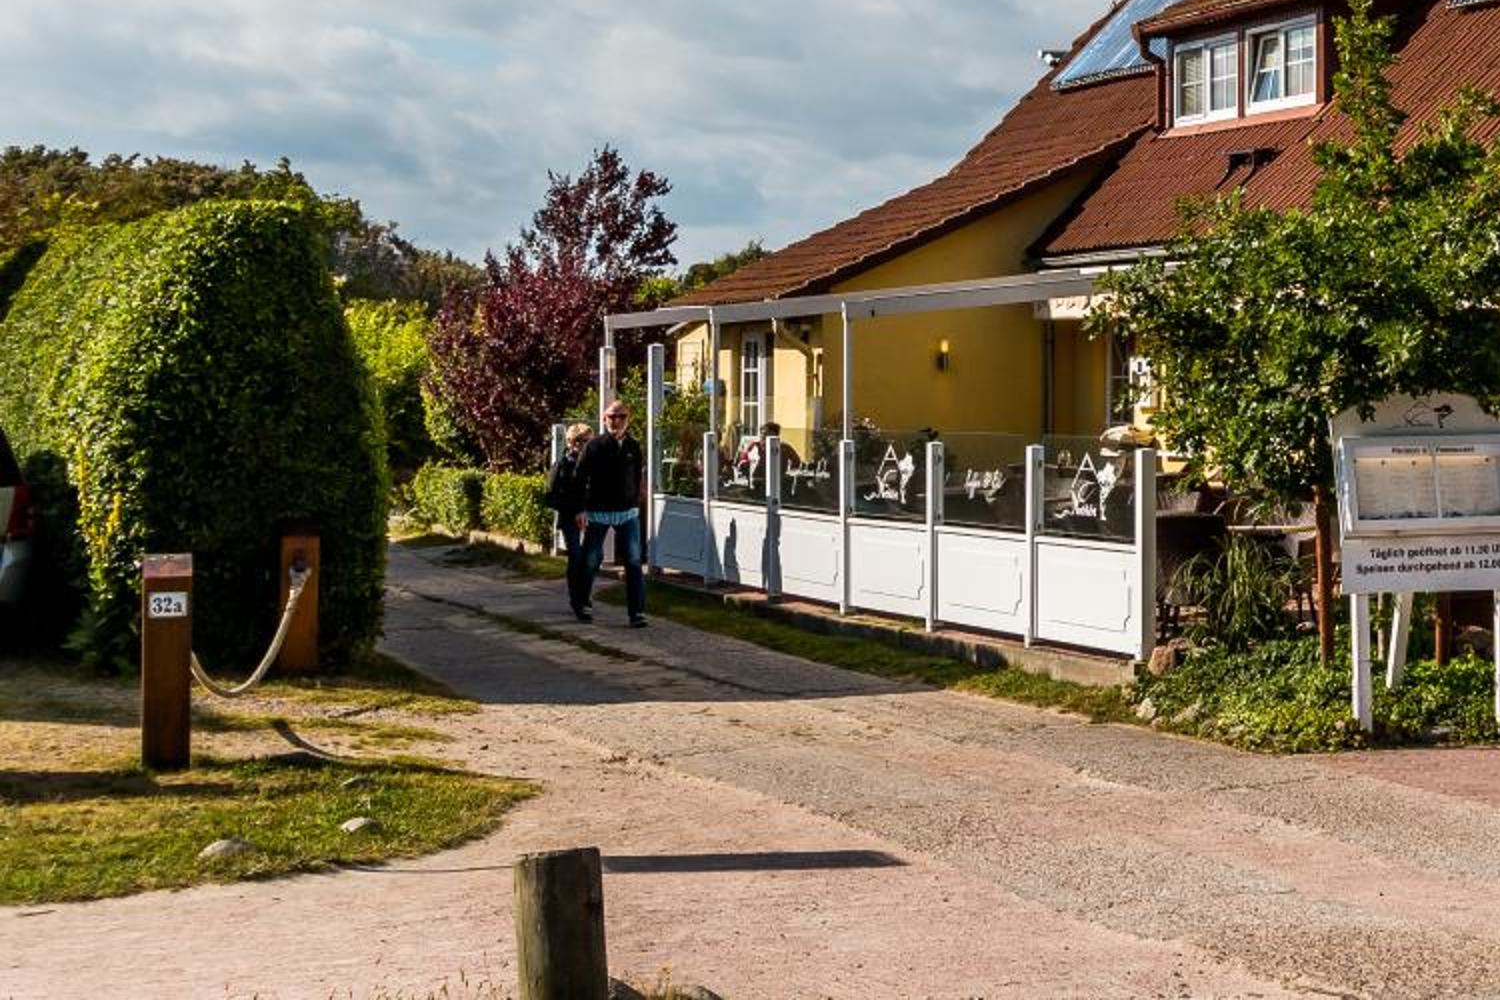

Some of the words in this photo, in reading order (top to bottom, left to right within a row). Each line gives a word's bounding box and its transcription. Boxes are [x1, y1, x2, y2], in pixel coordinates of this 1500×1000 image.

[1369, 547, 1405, 560] Täglich
[1407, 546, 1447, 559] geöffnet
[1450, 546, 1462, 556] ab
[1356, 563, 1395, 576] Speisen
[1397, 560, 1461, 573] durchgehend
[1463, 559, 1476, 570] ab
[152, 597, 183, 615] 32a
